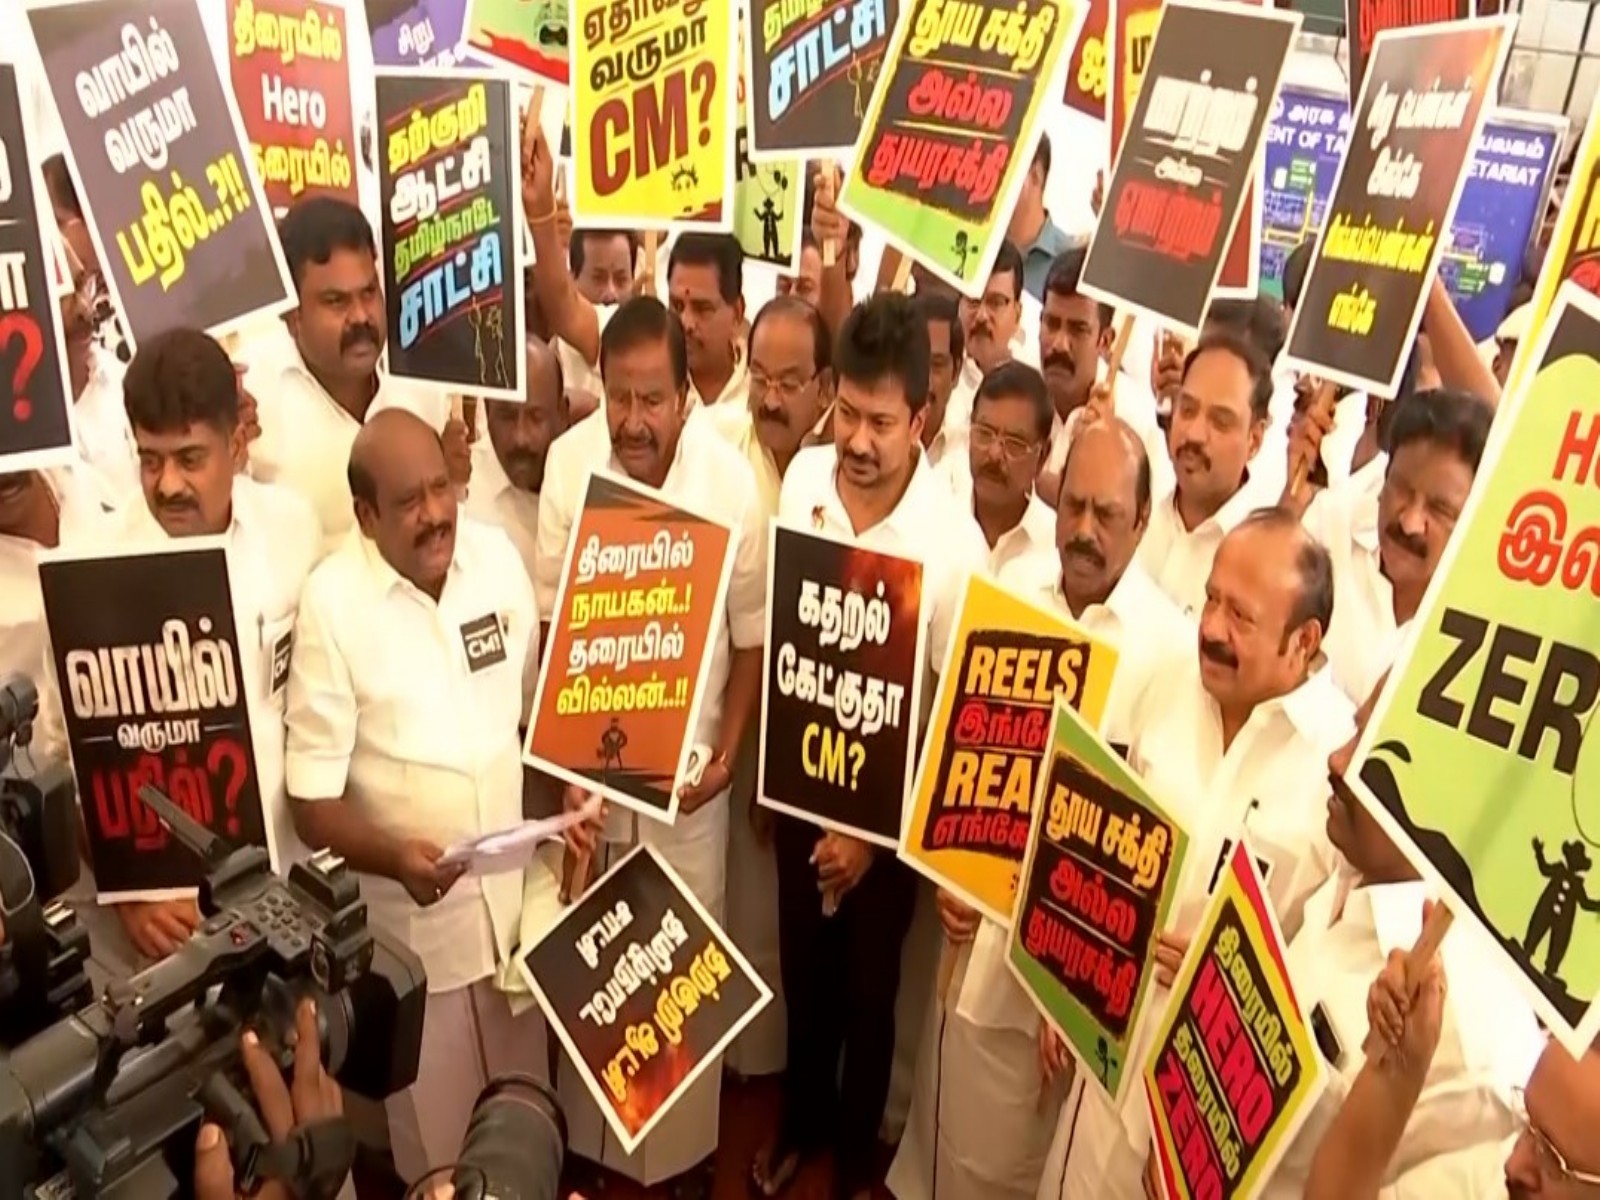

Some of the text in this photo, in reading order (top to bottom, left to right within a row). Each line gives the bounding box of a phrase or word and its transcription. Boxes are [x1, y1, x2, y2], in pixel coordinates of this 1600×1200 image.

[75, 16, 180, 119] வாயில்
[234, 0, 342, 64] திரையில்
[589, 15, 707, 92] வருமா
[909, 0, 984, 58] தூய
[979, 1, 1055, 72] சக்தி
[104, 87, 198, 173] வருமா
[261, 72, 327, 129] Hero
[388, 83, 487, 174] தற்குறி
[589, 60, 717, 198] CM?
[908, 68, 1013, 129] அல்ல
[1298, 130, 1323, 149] OF
[391, 136, 492, 224] ஆட்சி
[868, 132, 1010, 205] துயரசக்தி
[394, 197, 500, 284] தமிழ்நாடே
[400, 231, 503, 349] சாட்சி
[575, 529, 695, 584] திரையில்
[566, 622, 685, 676] தரையில்
[798, 579, 892, 652] கதறல்
[66, 616, 239, 719] வாயில்
[776, 642, 904, 736] கேட்குதா
[965, 645, 1083, 702] REELS
[1416, 607, 1600, 776] ZER
[117, 718, 201, 753] வருமா
[801, 722, 866, 791] CM?
[943, 750, 1033, 814] REA
[1046, 783, 1168, 888] தூய சக்தி
[575, 900, 634, 969] சாட்சி
[1050, 857, 1137, 942] அல்ல
[579, 908, 689, 1026] தமிழ்நாடே
[1026, 905, 1137, 1017] துயரசக்தி
[602, 940, 731, 1102] தற்குறி ஆட்சி
[1214, 924, 1293, 1087] திரையில்
[1190, 954, 1275, 1144] HERO
[1157, 1051, 1225, 1200] ZERO
[1173, 1022, 1241, 1179] தரையில்
